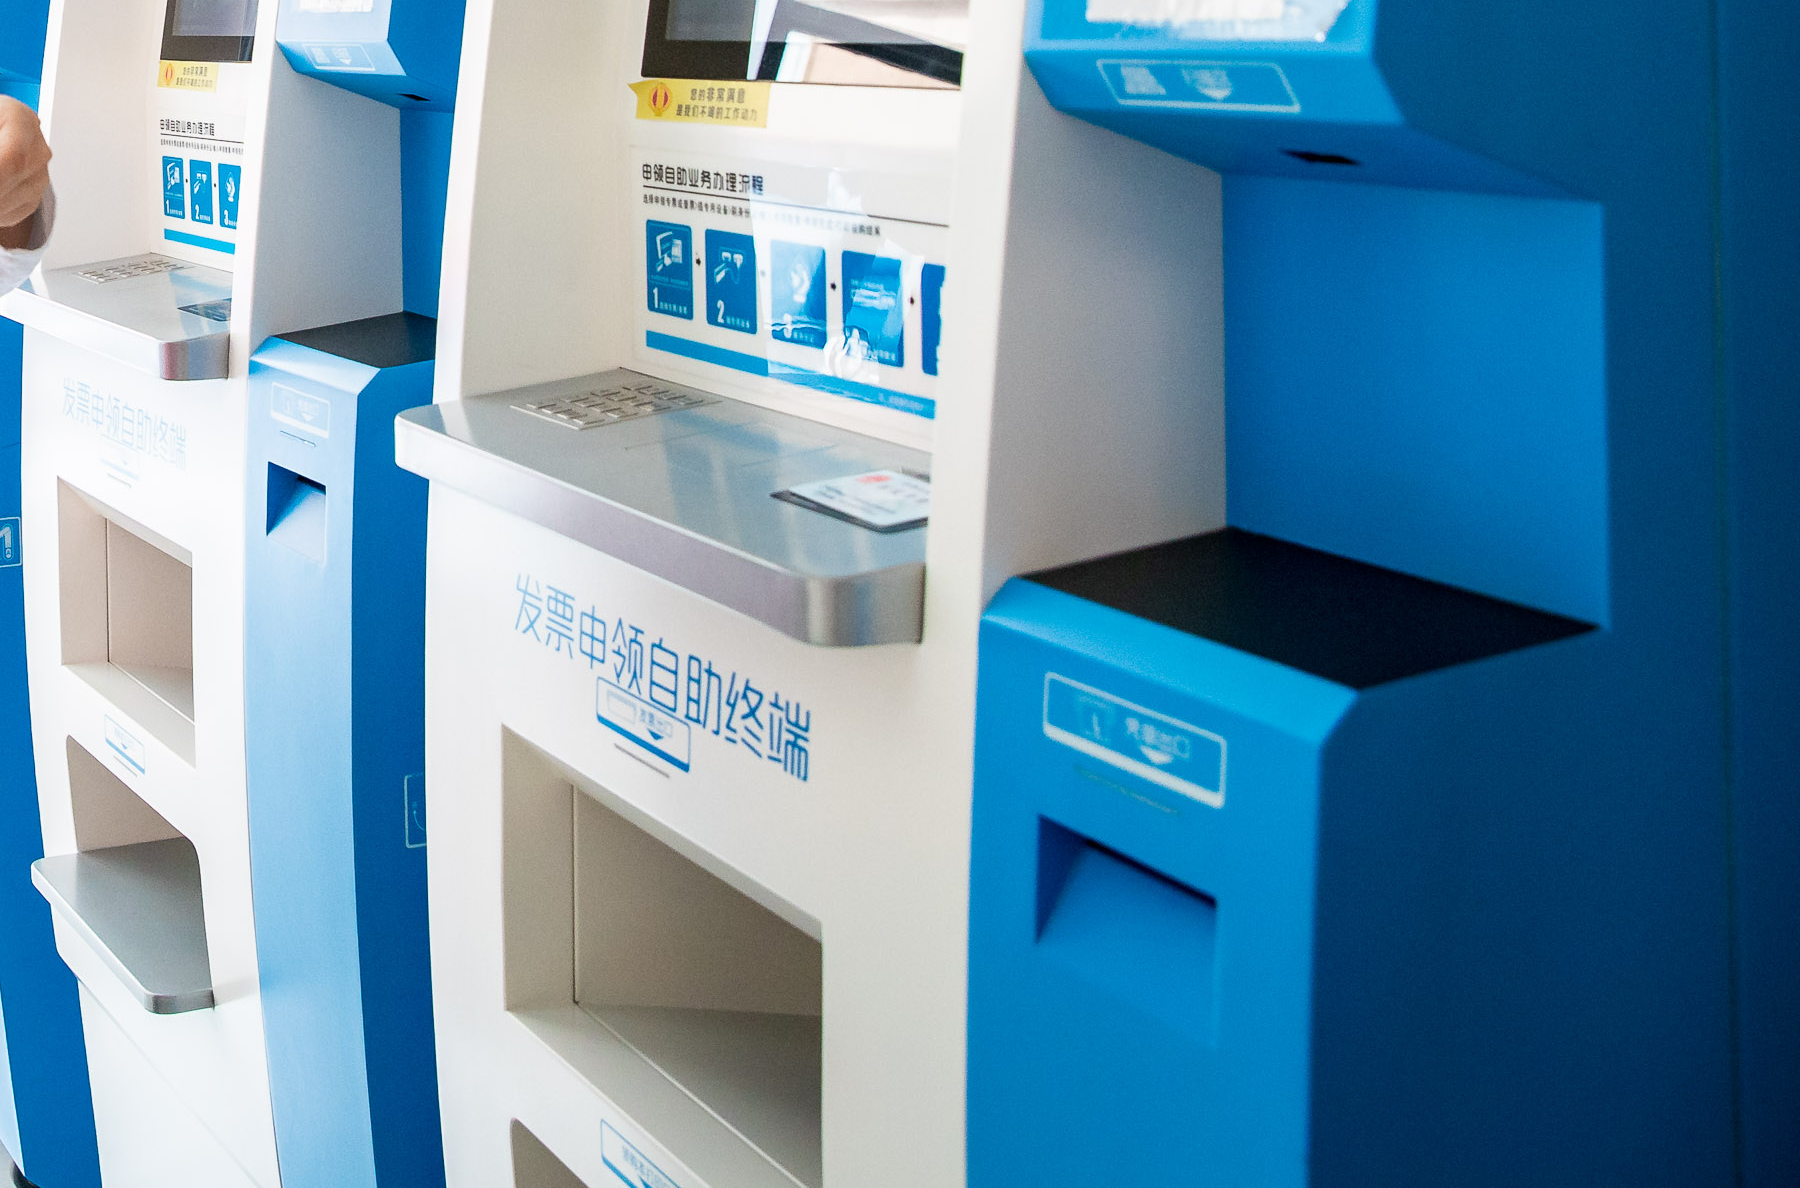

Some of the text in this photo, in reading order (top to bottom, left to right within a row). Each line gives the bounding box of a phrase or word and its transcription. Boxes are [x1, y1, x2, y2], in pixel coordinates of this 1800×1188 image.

[716, 299, 725, 324] 2
[63, 376, 188, 472] 发票申领自助终端
[515, 573, 812, 783] 发票申领自助终端
